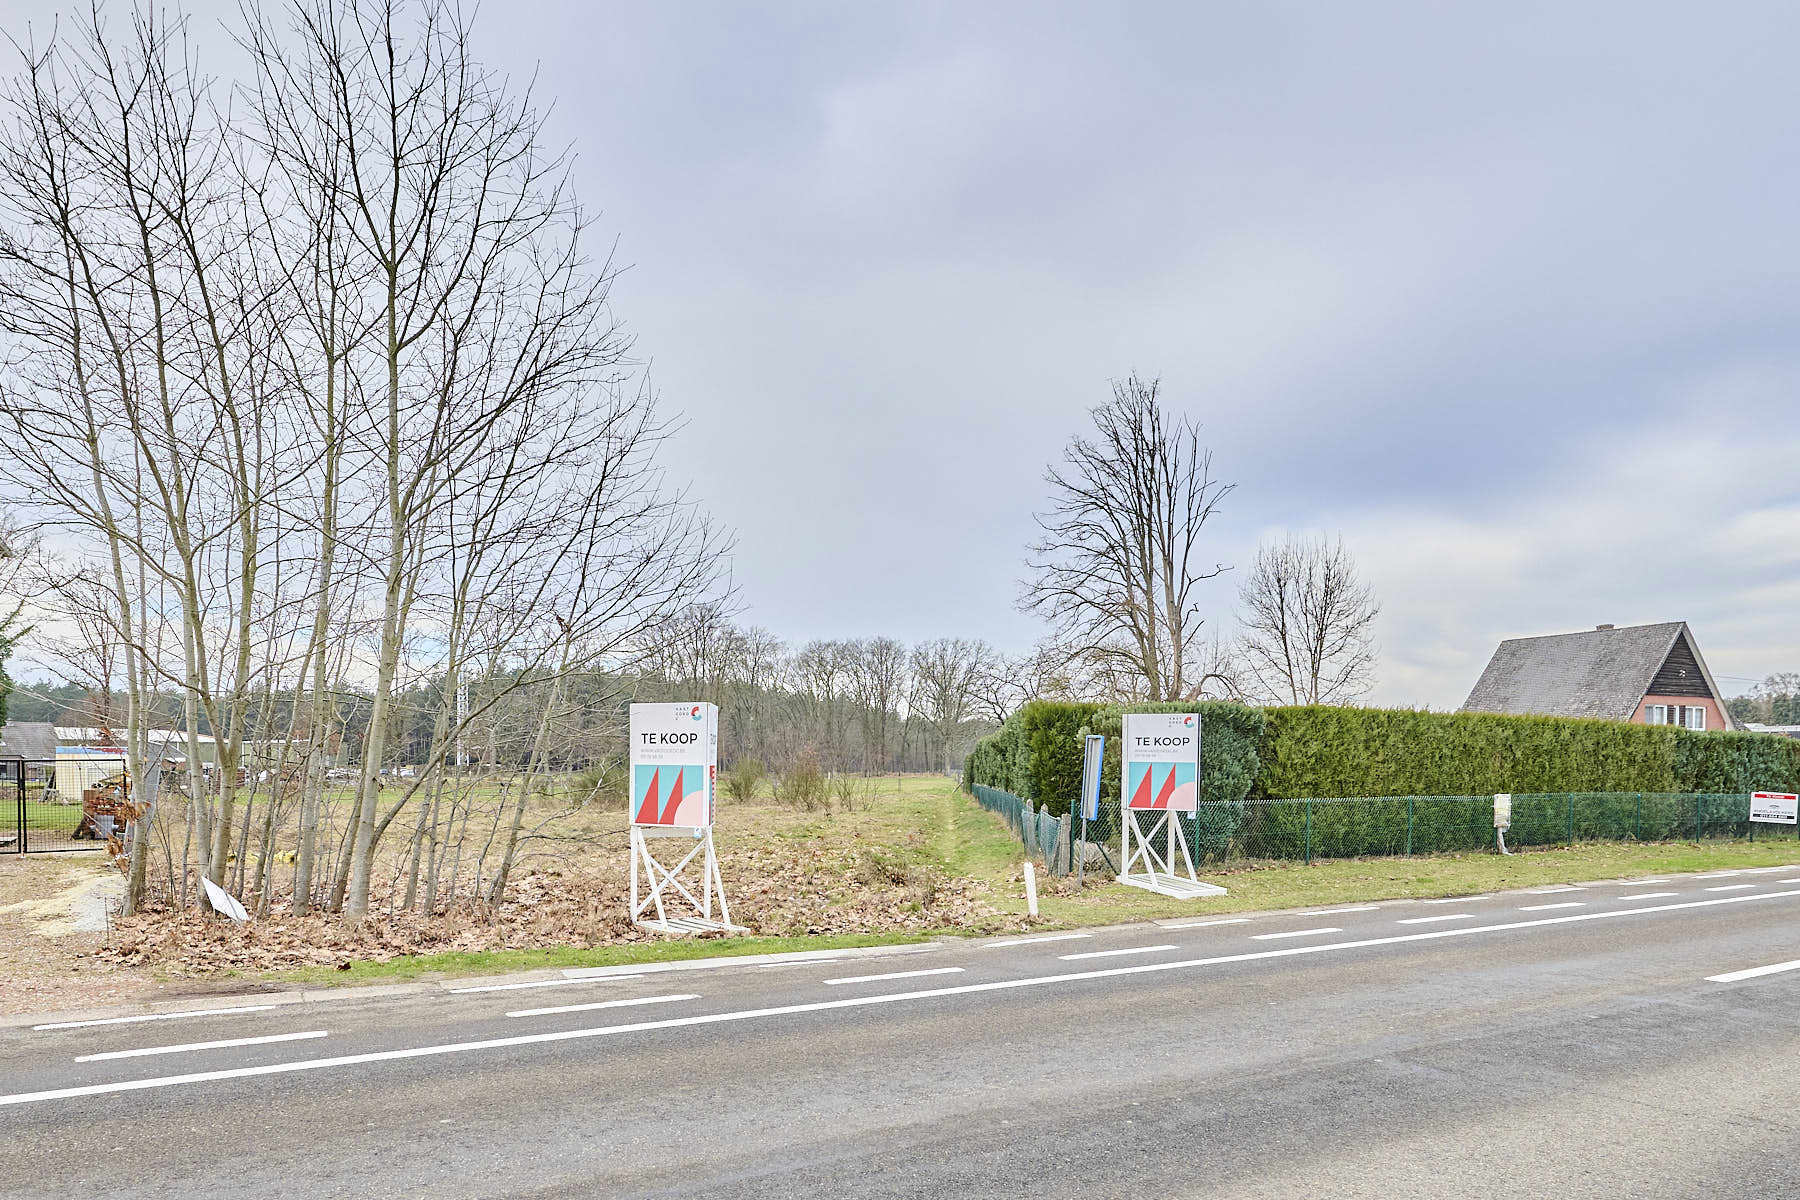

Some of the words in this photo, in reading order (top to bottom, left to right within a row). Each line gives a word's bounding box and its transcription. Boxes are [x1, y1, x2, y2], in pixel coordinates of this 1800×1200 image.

[641, 733, 657, 745] TE
[660, 733, 698, 745] KOOP
[1135, 737, 1150, 746] TE
[1154, 737, 1190, 746] KOOP
